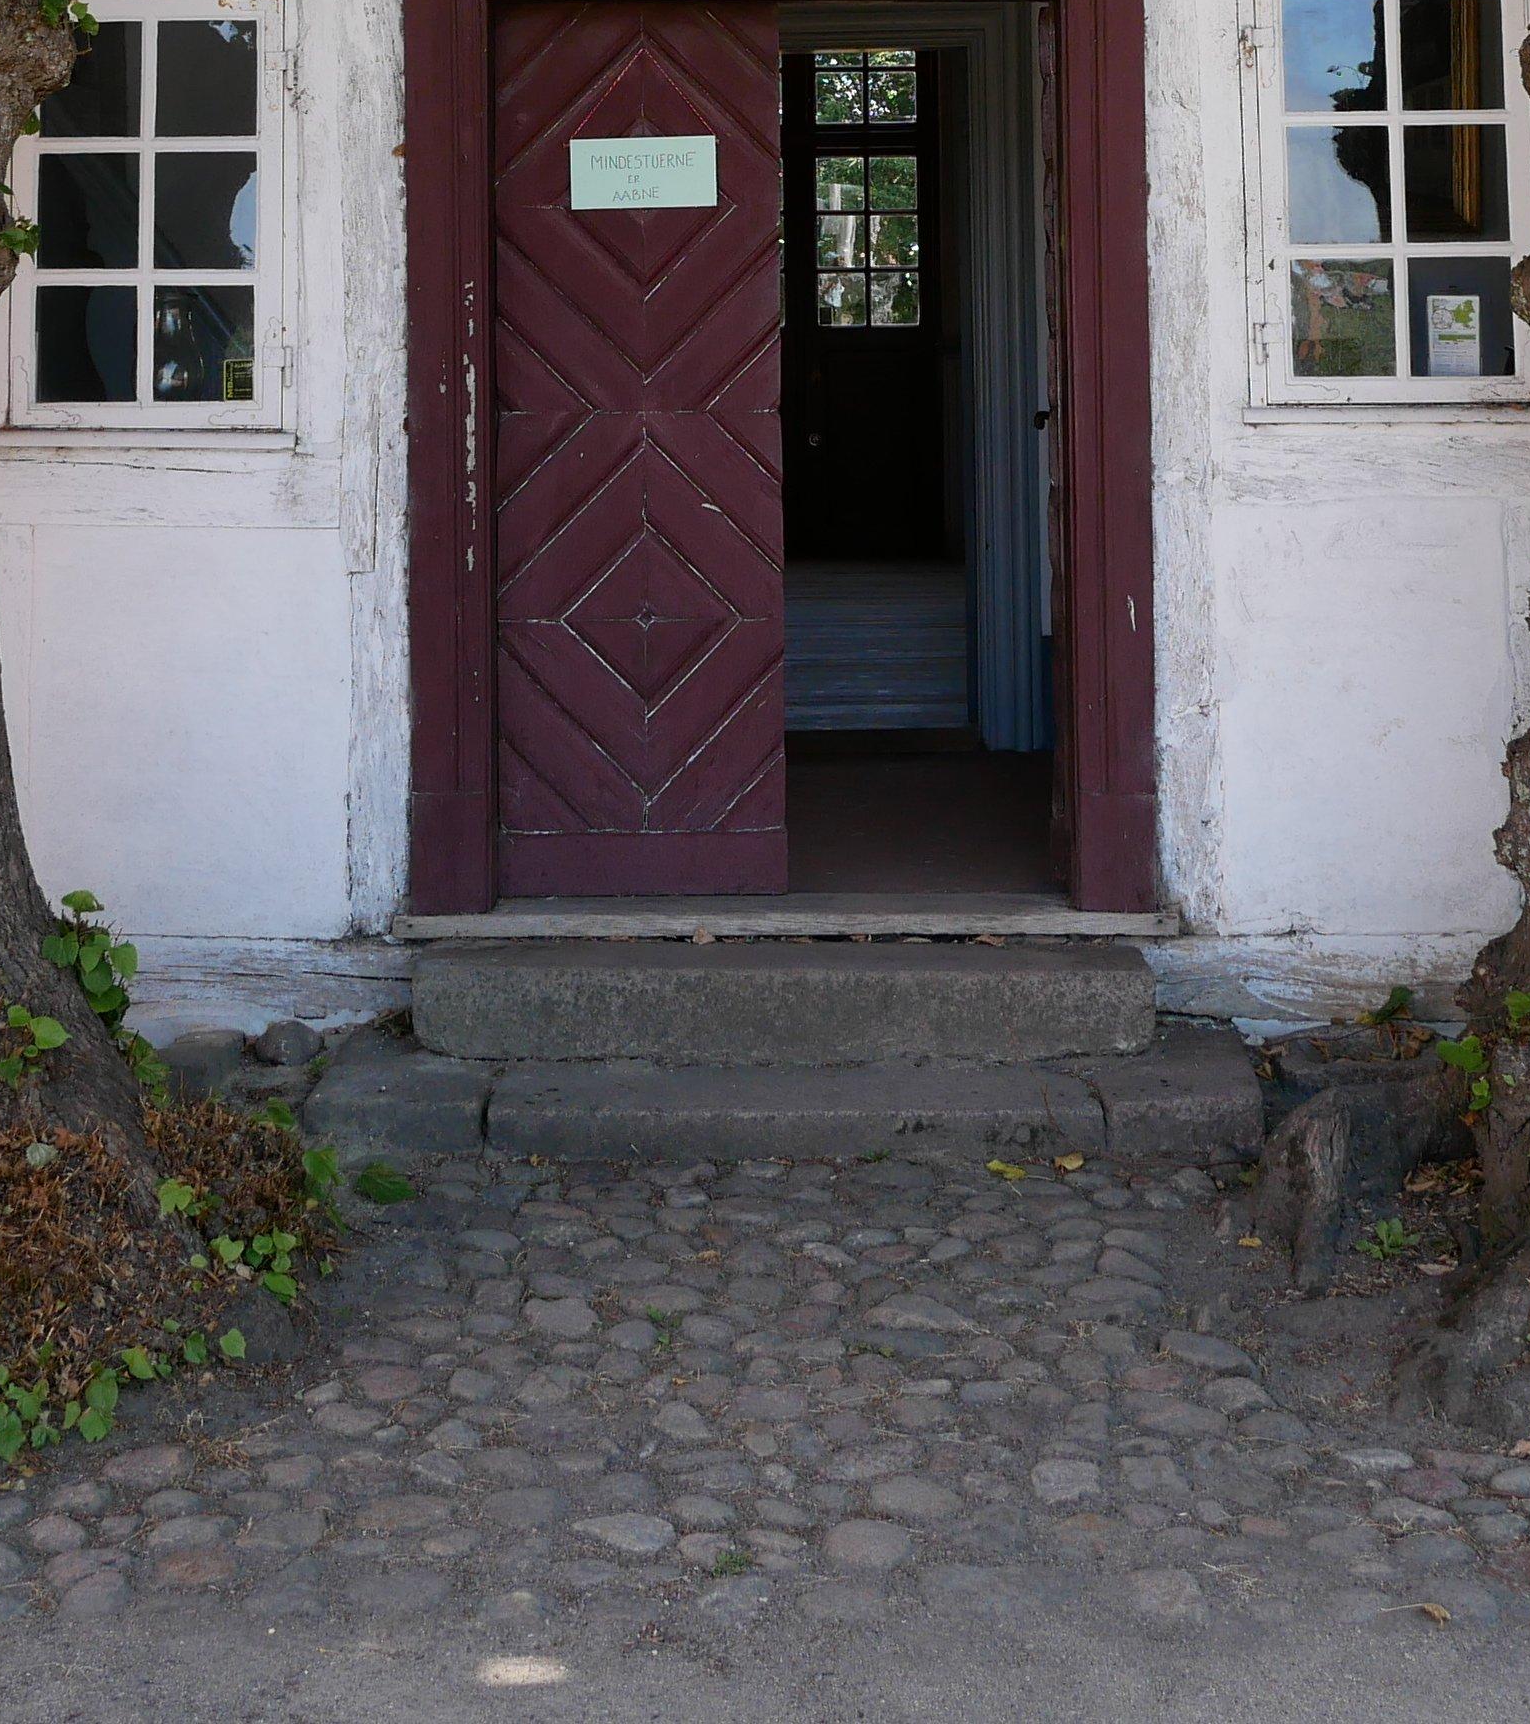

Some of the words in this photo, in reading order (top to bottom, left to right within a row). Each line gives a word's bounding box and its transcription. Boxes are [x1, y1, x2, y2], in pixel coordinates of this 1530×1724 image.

[591, 151, 696, 170] MINDESTUERNE
[628, 175, 640, 183] ER
[613, 187, 659, 202] AABNE
